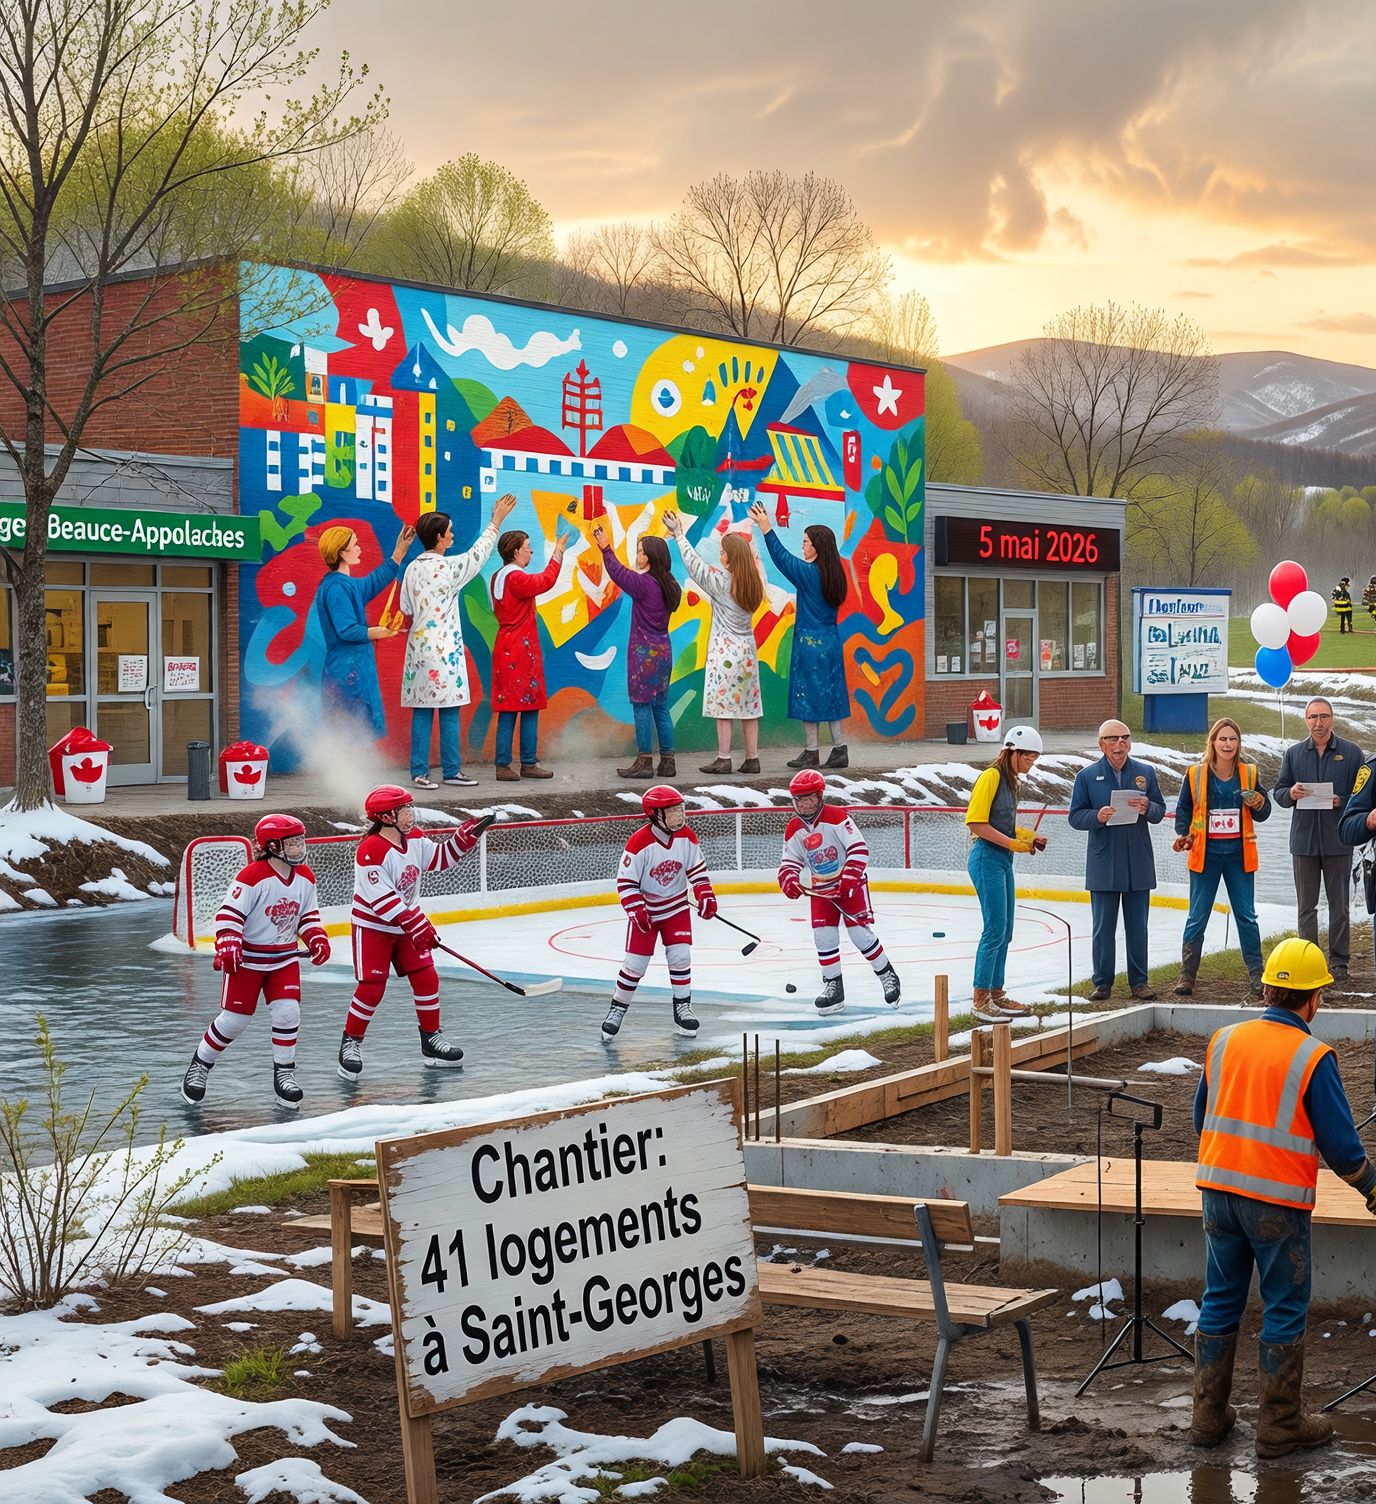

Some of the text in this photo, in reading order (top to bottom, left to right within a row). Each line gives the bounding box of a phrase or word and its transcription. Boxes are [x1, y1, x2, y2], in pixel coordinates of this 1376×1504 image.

[979, 525, 1099, 563] 5 mai 2026
[471, 1122, 667, 1204] Chantier:
[421, 1186, 702, 1293] 41 logements
[422, 1255, 746, 1376] à Saint-Georges
